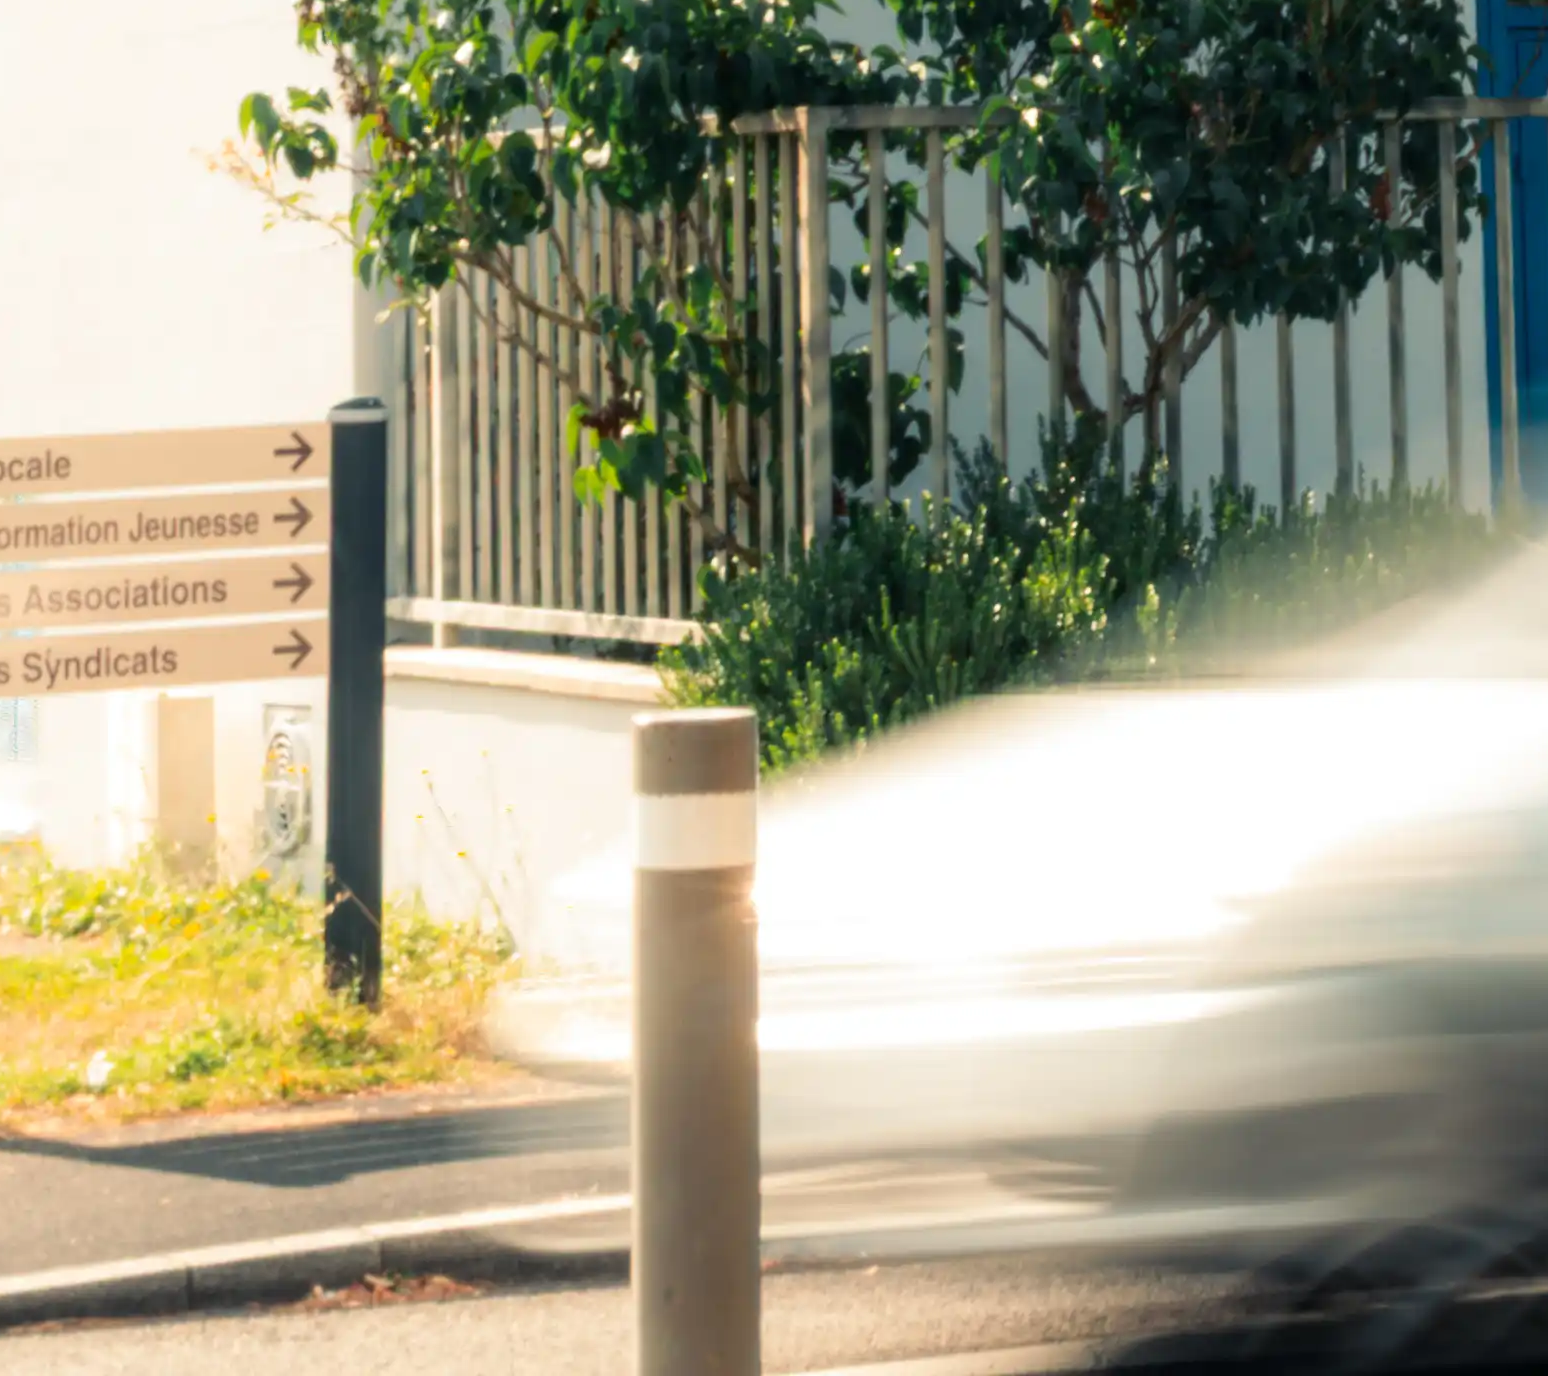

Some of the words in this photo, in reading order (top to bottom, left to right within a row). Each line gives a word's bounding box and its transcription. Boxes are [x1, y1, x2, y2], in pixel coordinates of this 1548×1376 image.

[128, 510, 260, 543] Jeunesse
[22, 576, 228, 616] Associations
[21, 645, 179, 691] Syndicats
